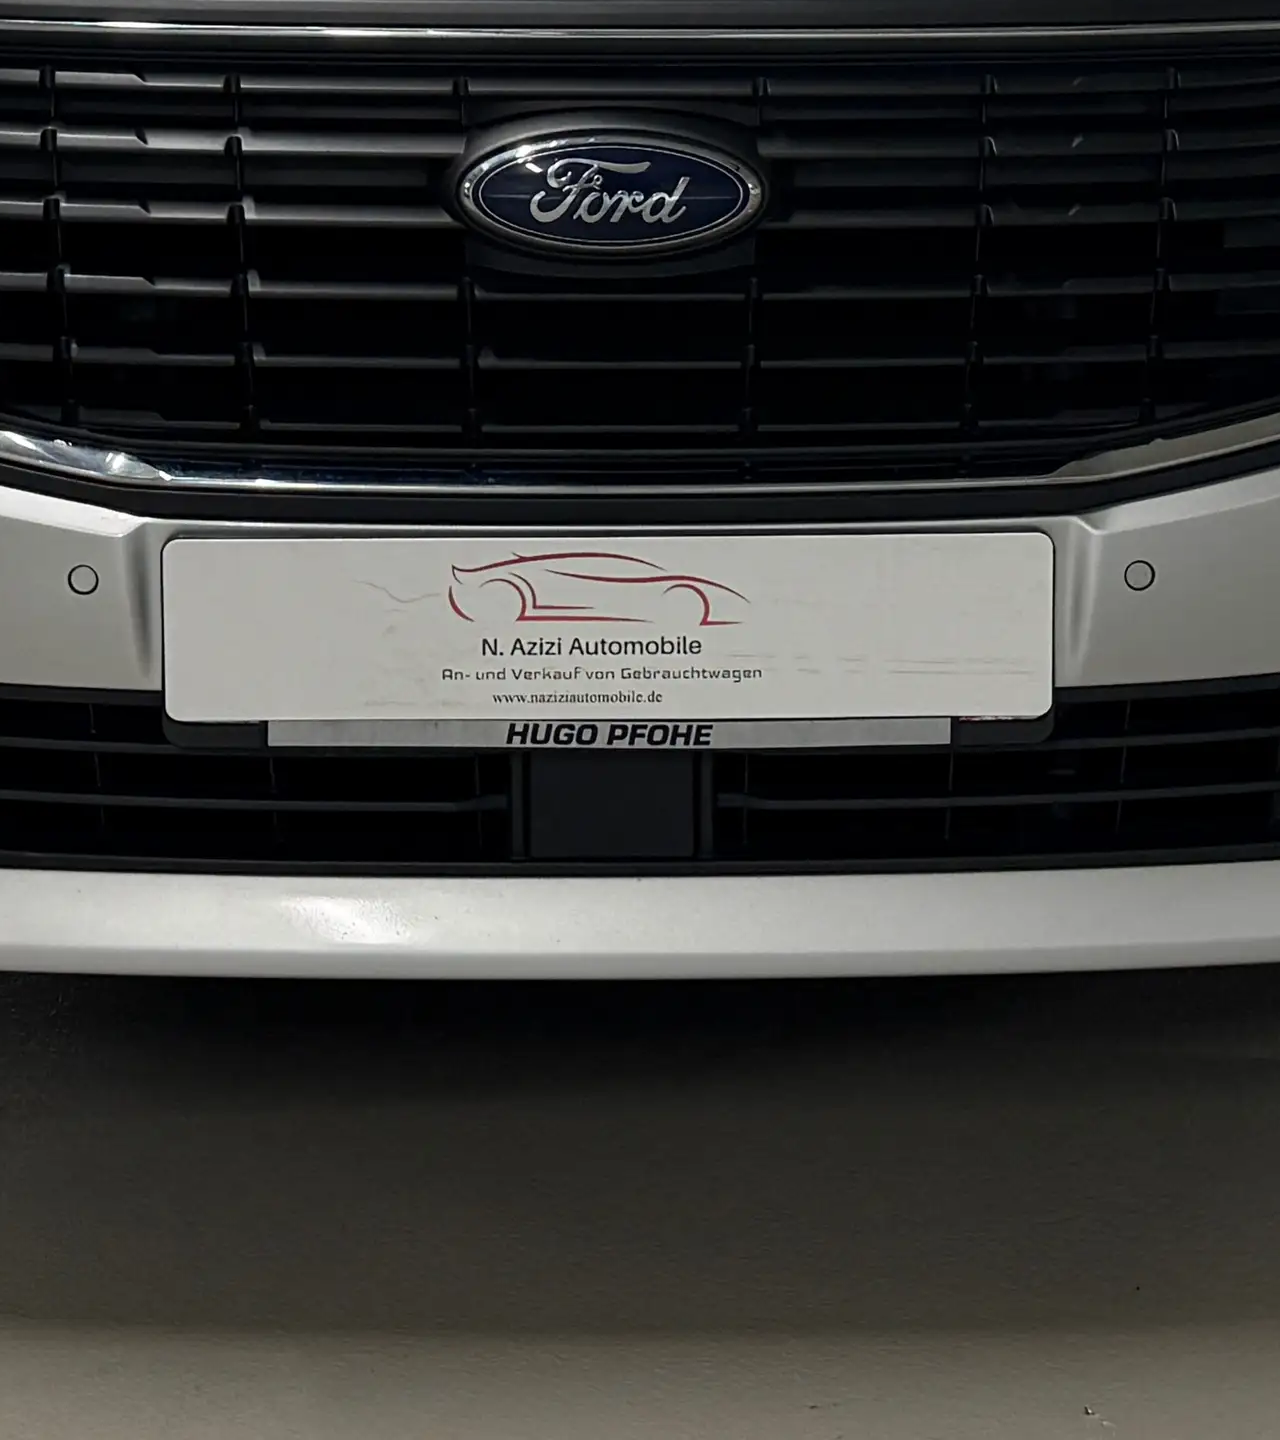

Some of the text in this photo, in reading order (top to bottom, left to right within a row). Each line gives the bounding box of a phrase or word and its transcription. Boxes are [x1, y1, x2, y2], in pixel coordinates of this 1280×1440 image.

[528, 157, 691, 224] Ford
[482, 635, 702, 657] N. Azizi Automobile
[441, 666, 762, 684] An- und Verkauf von Gebrauchtwagen
[492, 690, 663, 704] www.naziziautomobile.de
[505, 722, 714, 747] HUGO PFOHE
